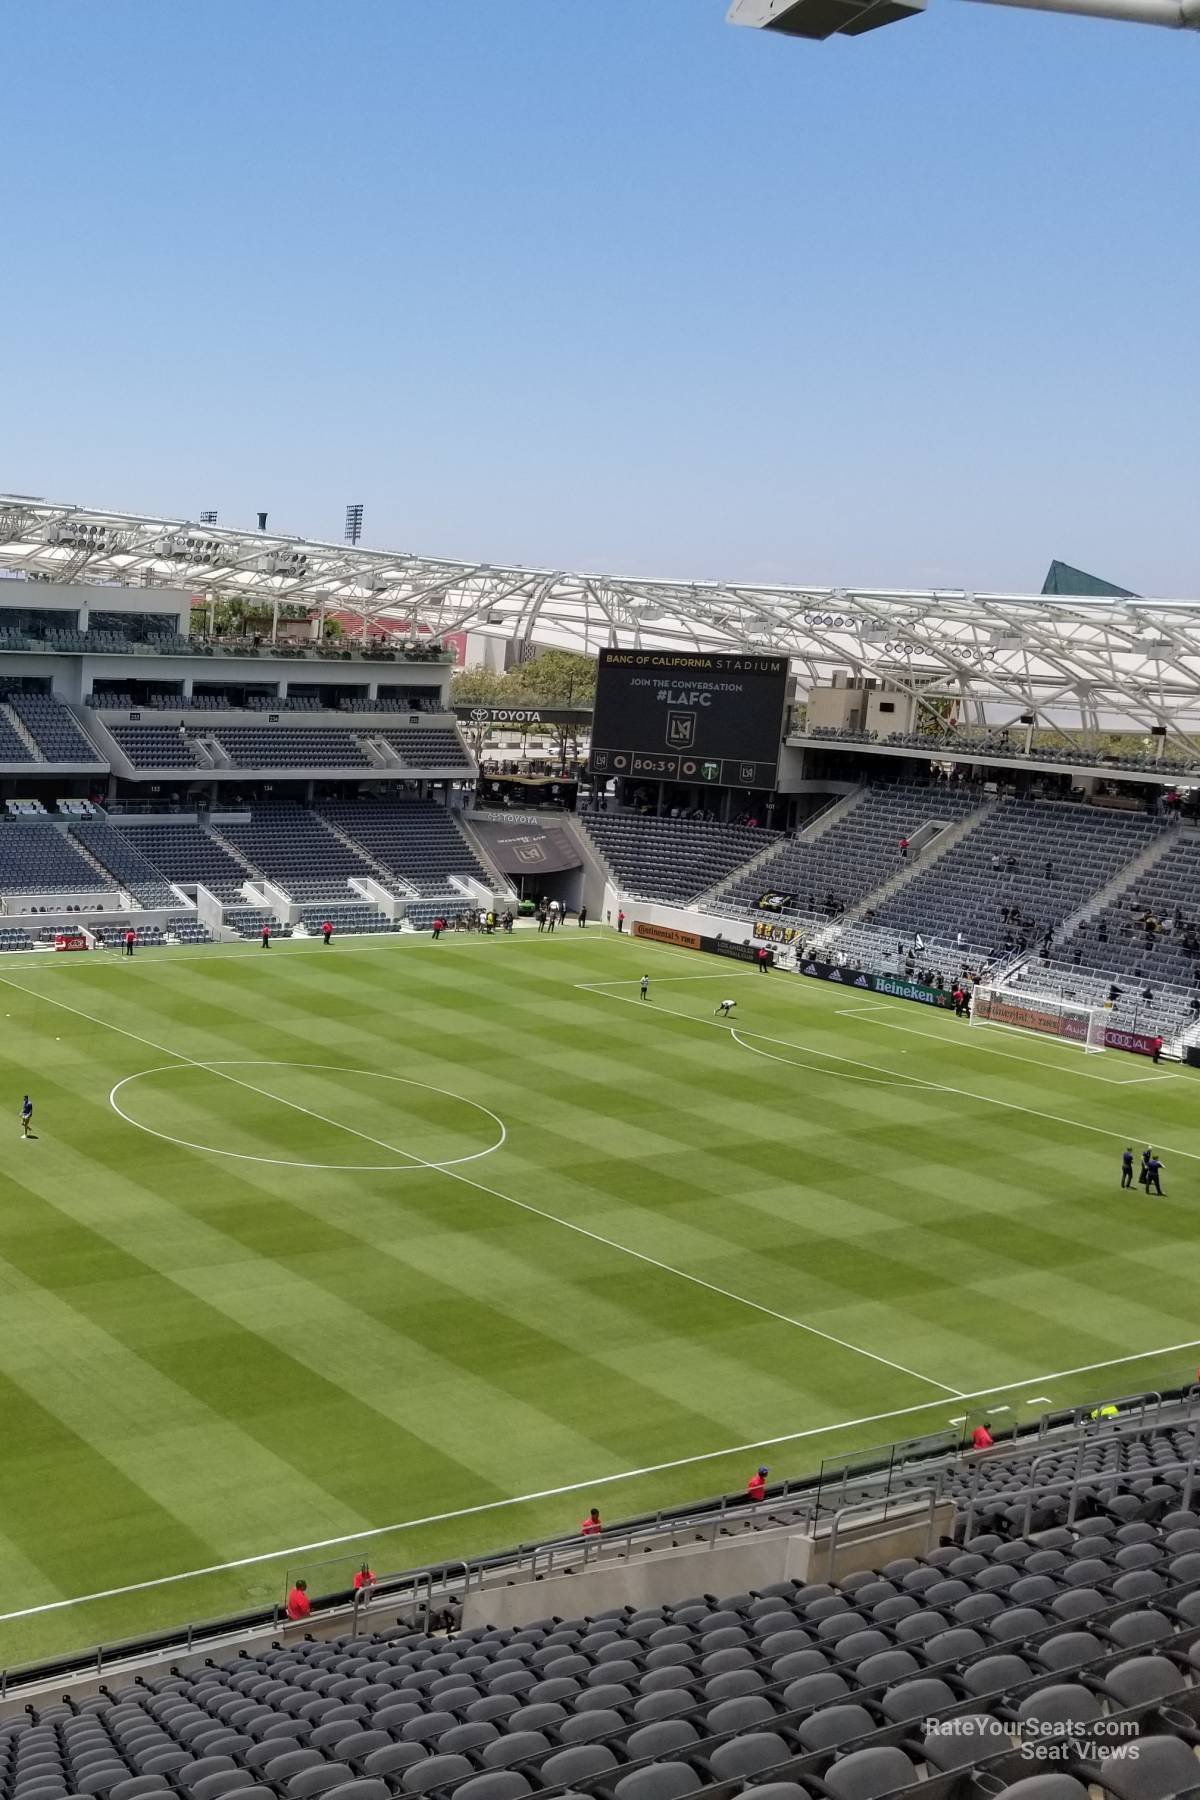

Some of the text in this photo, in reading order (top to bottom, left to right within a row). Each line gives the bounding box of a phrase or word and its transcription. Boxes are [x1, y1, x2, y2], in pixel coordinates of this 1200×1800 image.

[606, 655, 780, 672] BANC OF CALIFORNIA STADIUM
[629, 678, 743, 692] JOIN THE CONVERSATION
[656, 690, 712, 706] #LAFC
[491, 710, 541, 722] TOYOTA
[634, 759, 676, 772] 80:39
[502, 813, 538, 825] TOYOTA
[875, 978, 934, 1003] Heineken
